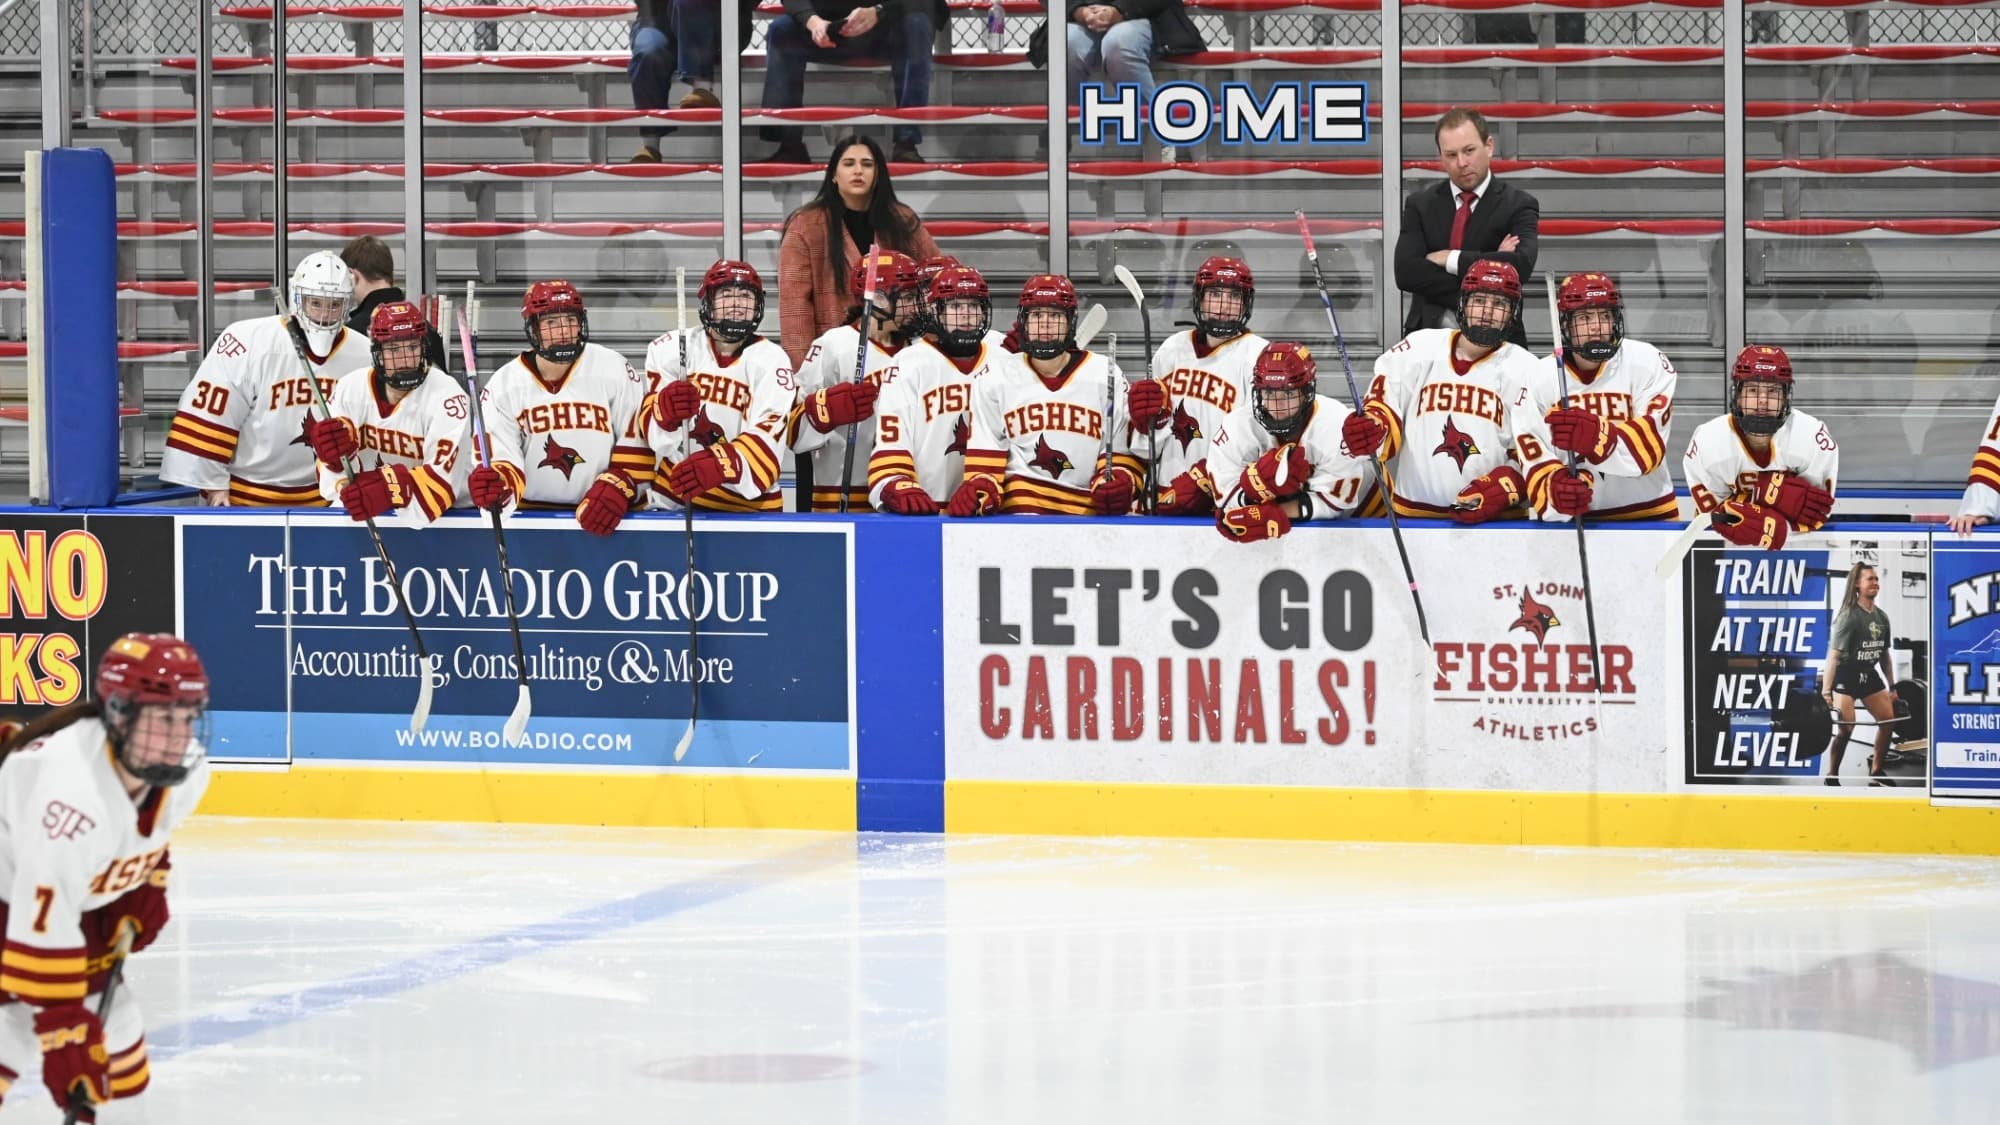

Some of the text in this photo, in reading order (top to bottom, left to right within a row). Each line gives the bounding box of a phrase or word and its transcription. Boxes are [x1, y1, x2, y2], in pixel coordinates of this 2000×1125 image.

[1080, 81, 1369, 145] HOME
[217, 333, 247, 359] SJF
[268, 377, 338, 412] FISH
[775, 367, 797, 392] SJ
[191, 380, 231, 417] 30
[879, 415, 900, 443] 5
[1003, 401, 1103, 441] FISHER
[1815, 424, 1837, 452] SJ
[1517, 433, 1543, 462] 6
[1329, 477, 1361, 504] 11
[248, 553, 779, 622] THE BONADIO GROUP
[1493, 582, 1584, 600] ST. JOHN
[1714, 559, 1806, 595] TRAIN
[979, 567, 1374, 651] LET'S GO
[1711, 616, 1817, 653] AT THE
[291, 642, 450, 689] Accounting,
[454, 643, 603, 691] Consulting
[1432, 642, 1637, 694] FISHER
[979, 654, 1377, 746] CARDINALS!
[1487, 697, 1582, 705] UNIVERSITY
[1713, 673, 1796, 710] NEXT
[395, 729, 632, 751] WWW.BONADIO.COM
[1472, 715, 1598, 741] ATHLETICS
[1713, 731, 1812, 768] LEVEL.
[1964, 749, 2000, 762] Train
[42, 799, 97, 841] SJF
[33, 885, 54, 933] 7
